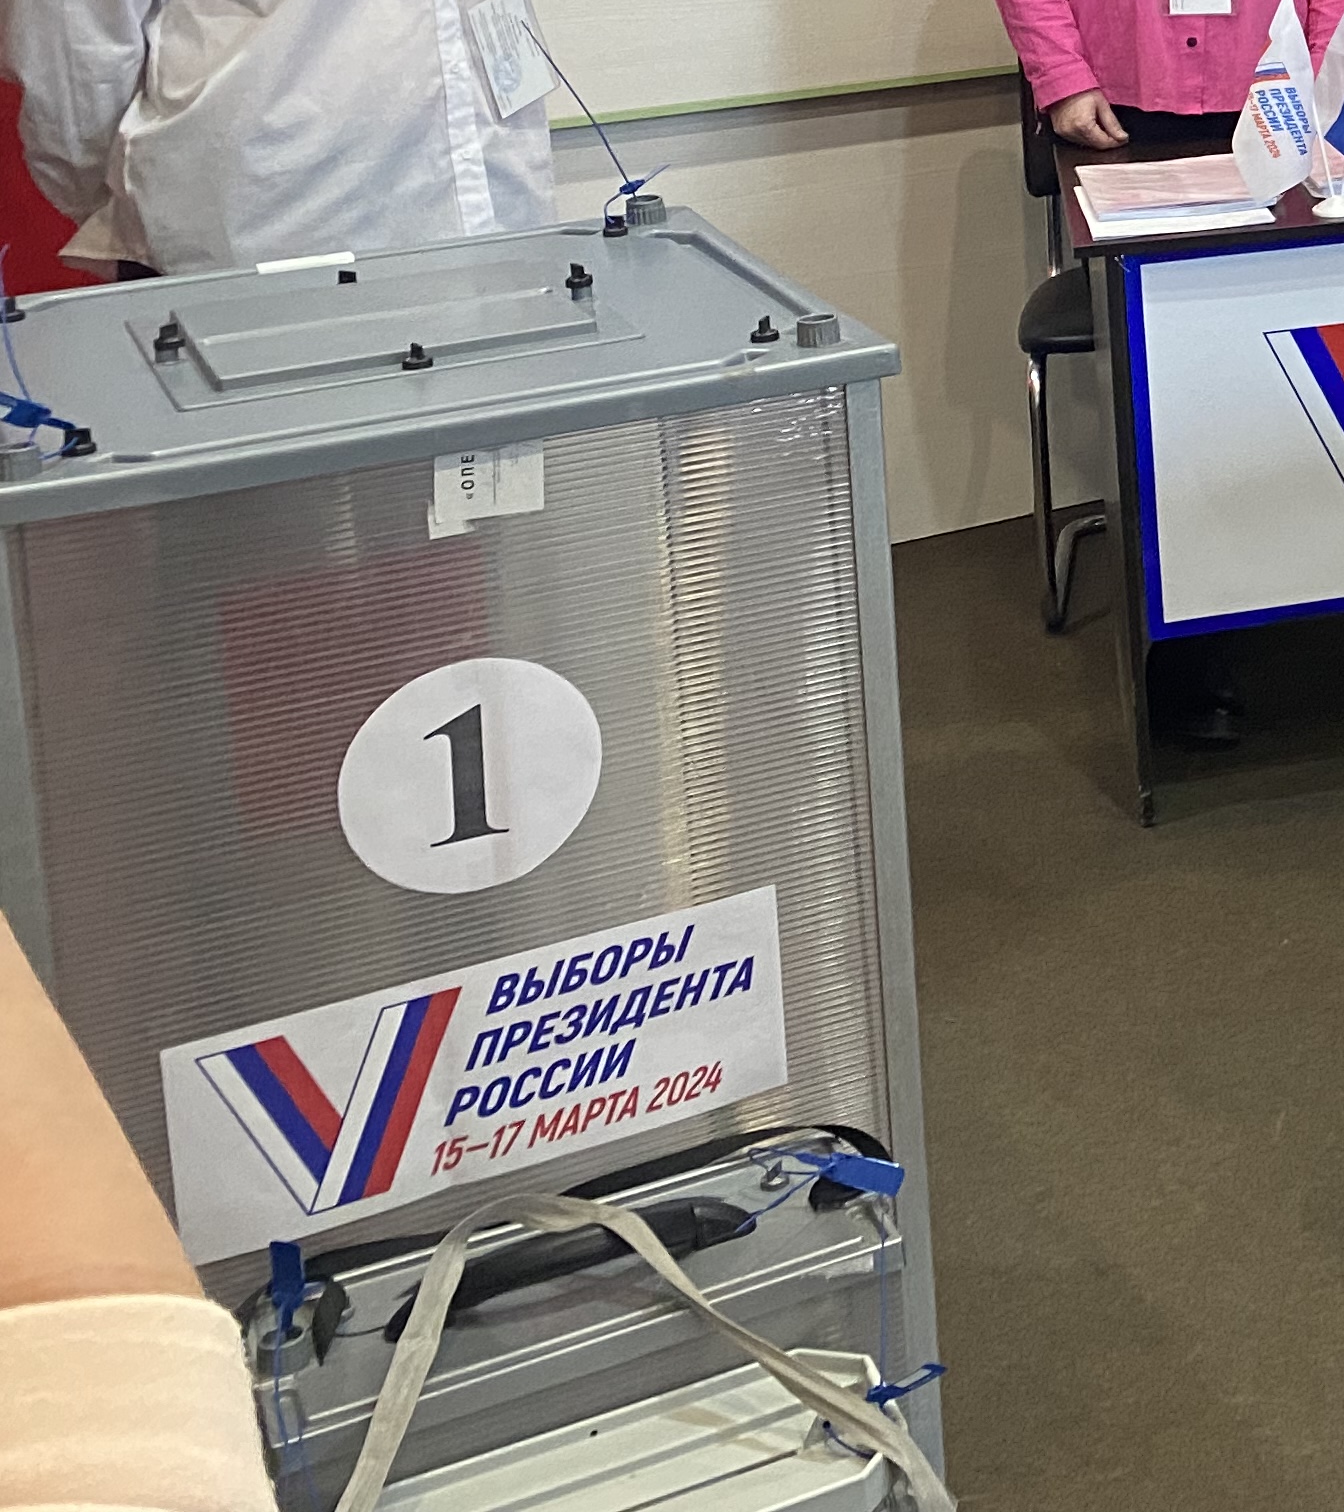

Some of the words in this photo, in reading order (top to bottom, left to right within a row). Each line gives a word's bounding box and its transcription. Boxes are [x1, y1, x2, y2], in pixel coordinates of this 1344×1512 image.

[1255, 90, 1284, 132] РОССИИ
[1269, 88, 1308, 156] ПРЕЗИДЕНТА
[1284, 87, 1312, 134] ВЫБОРЫ
[423, 703, 510, 848] 1
[464, 956, 755, 1072] ПРЕЗИДЕНТА
[485, 924, 695, 1016] ВЫБОРЫ
[443, 1038, 637, 1127] РОССИИ
[527, 1085, 640, 1150] МАРТА
[645, 1060, 723, 1114] 2024
